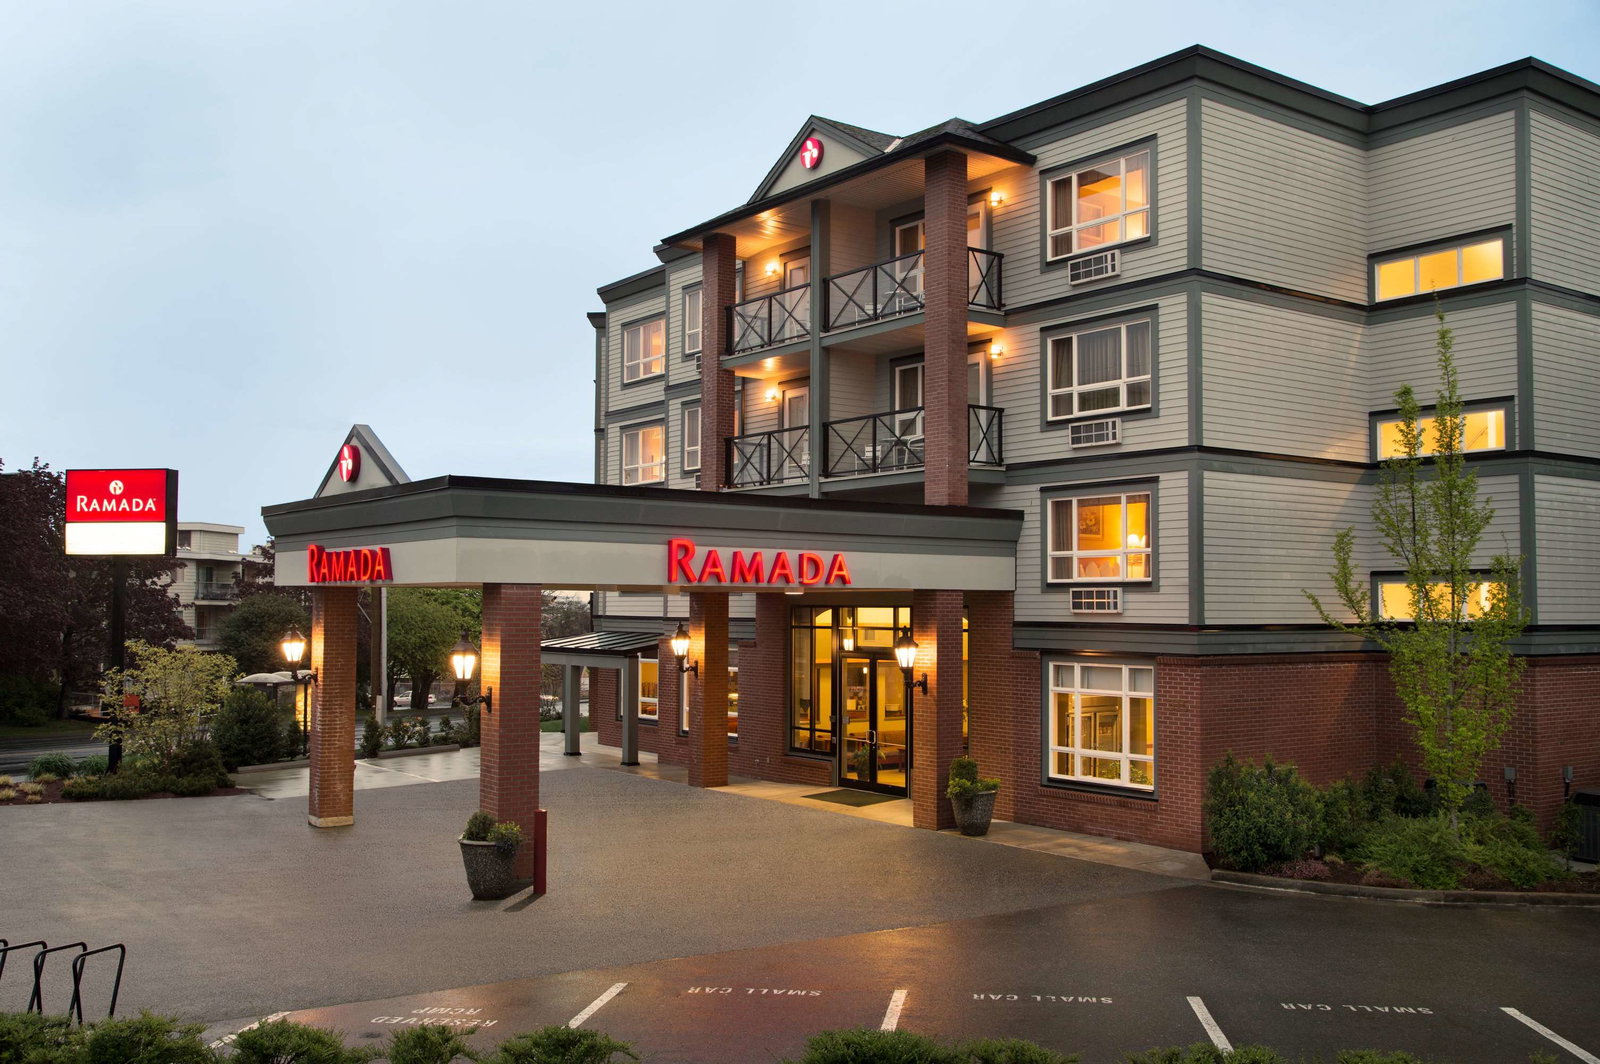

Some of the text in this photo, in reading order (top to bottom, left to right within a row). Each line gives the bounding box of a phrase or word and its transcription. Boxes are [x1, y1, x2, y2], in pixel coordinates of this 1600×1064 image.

[76, 495, 156, 512] RAMADA
[308, 544, 394, 583] RAMADA
[667, 537, 852, 585] RAMADA
[687, 986, 822, 997] SMALL CAR
[972, 993, 1113, 1004] SMALL CAR
[1280, 1002, 1434, 1015] SMALL CAR
[370, 1016, 499, 1028] RESERVED
